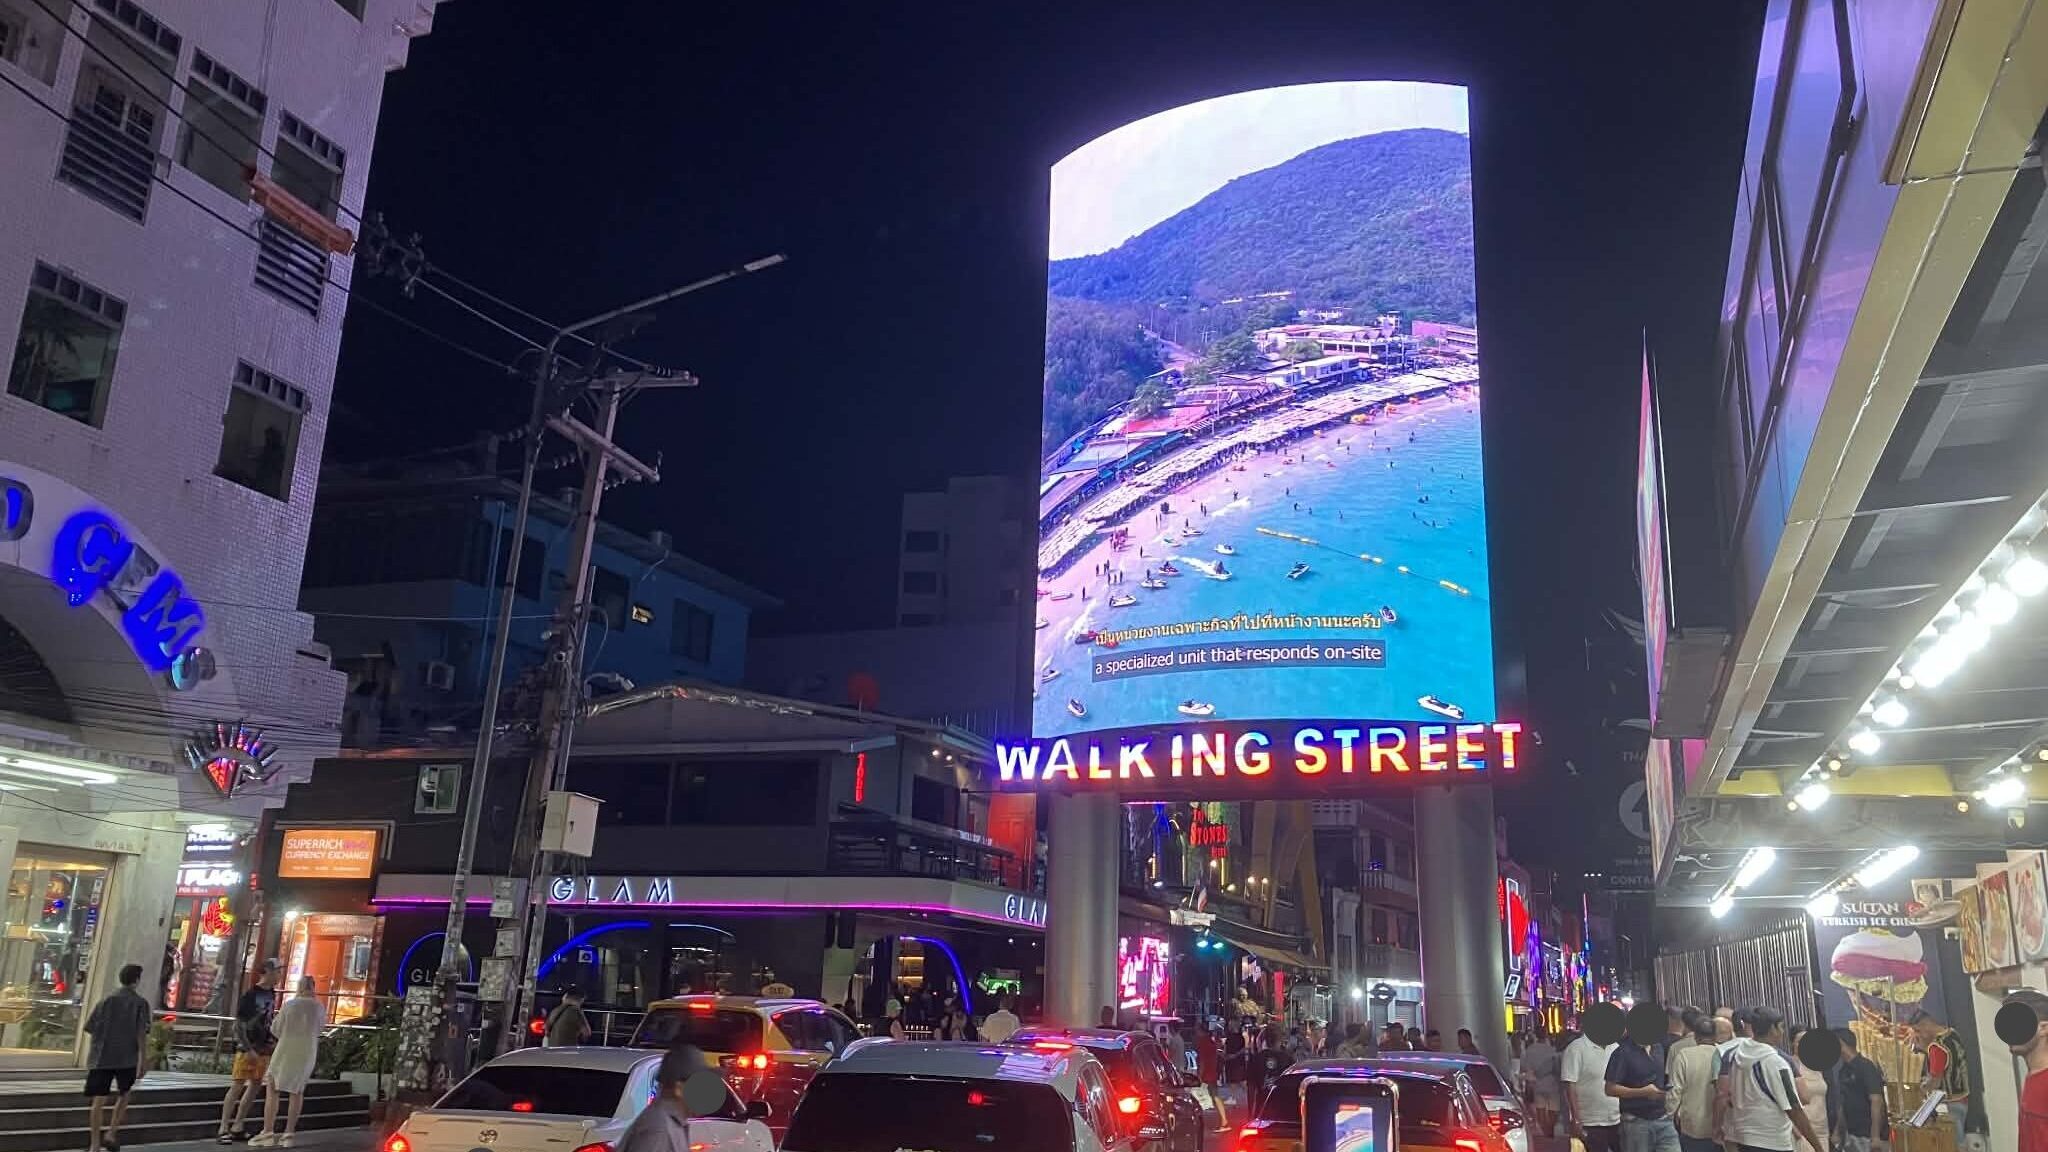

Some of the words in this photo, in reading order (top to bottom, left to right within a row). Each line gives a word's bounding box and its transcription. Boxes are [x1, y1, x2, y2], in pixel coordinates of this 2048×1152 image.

[1095, 662, 1103, 674] a
[1106, 651, 1174, 675] specialized
[1178, 649, 1206, 665] unit
[1211, 647, 1242, 662] that
[1246, 645, 1319, 662] responds
[1324, 645, 1382, 660] on-site
[996, 732, 1271, 781] WALKING
[1293, 723, 1521, 774] STREET
[287, 838, 343, 849] SUPERRICH
[551, 876, 673, 903] GLAM
[1842, 901, 1900, 916] SULTAN
[1822, 916, 1868, 927] TURKISH
[1870, 916, 1889, 927] ICE
[410, 968, 432, 983] GL
